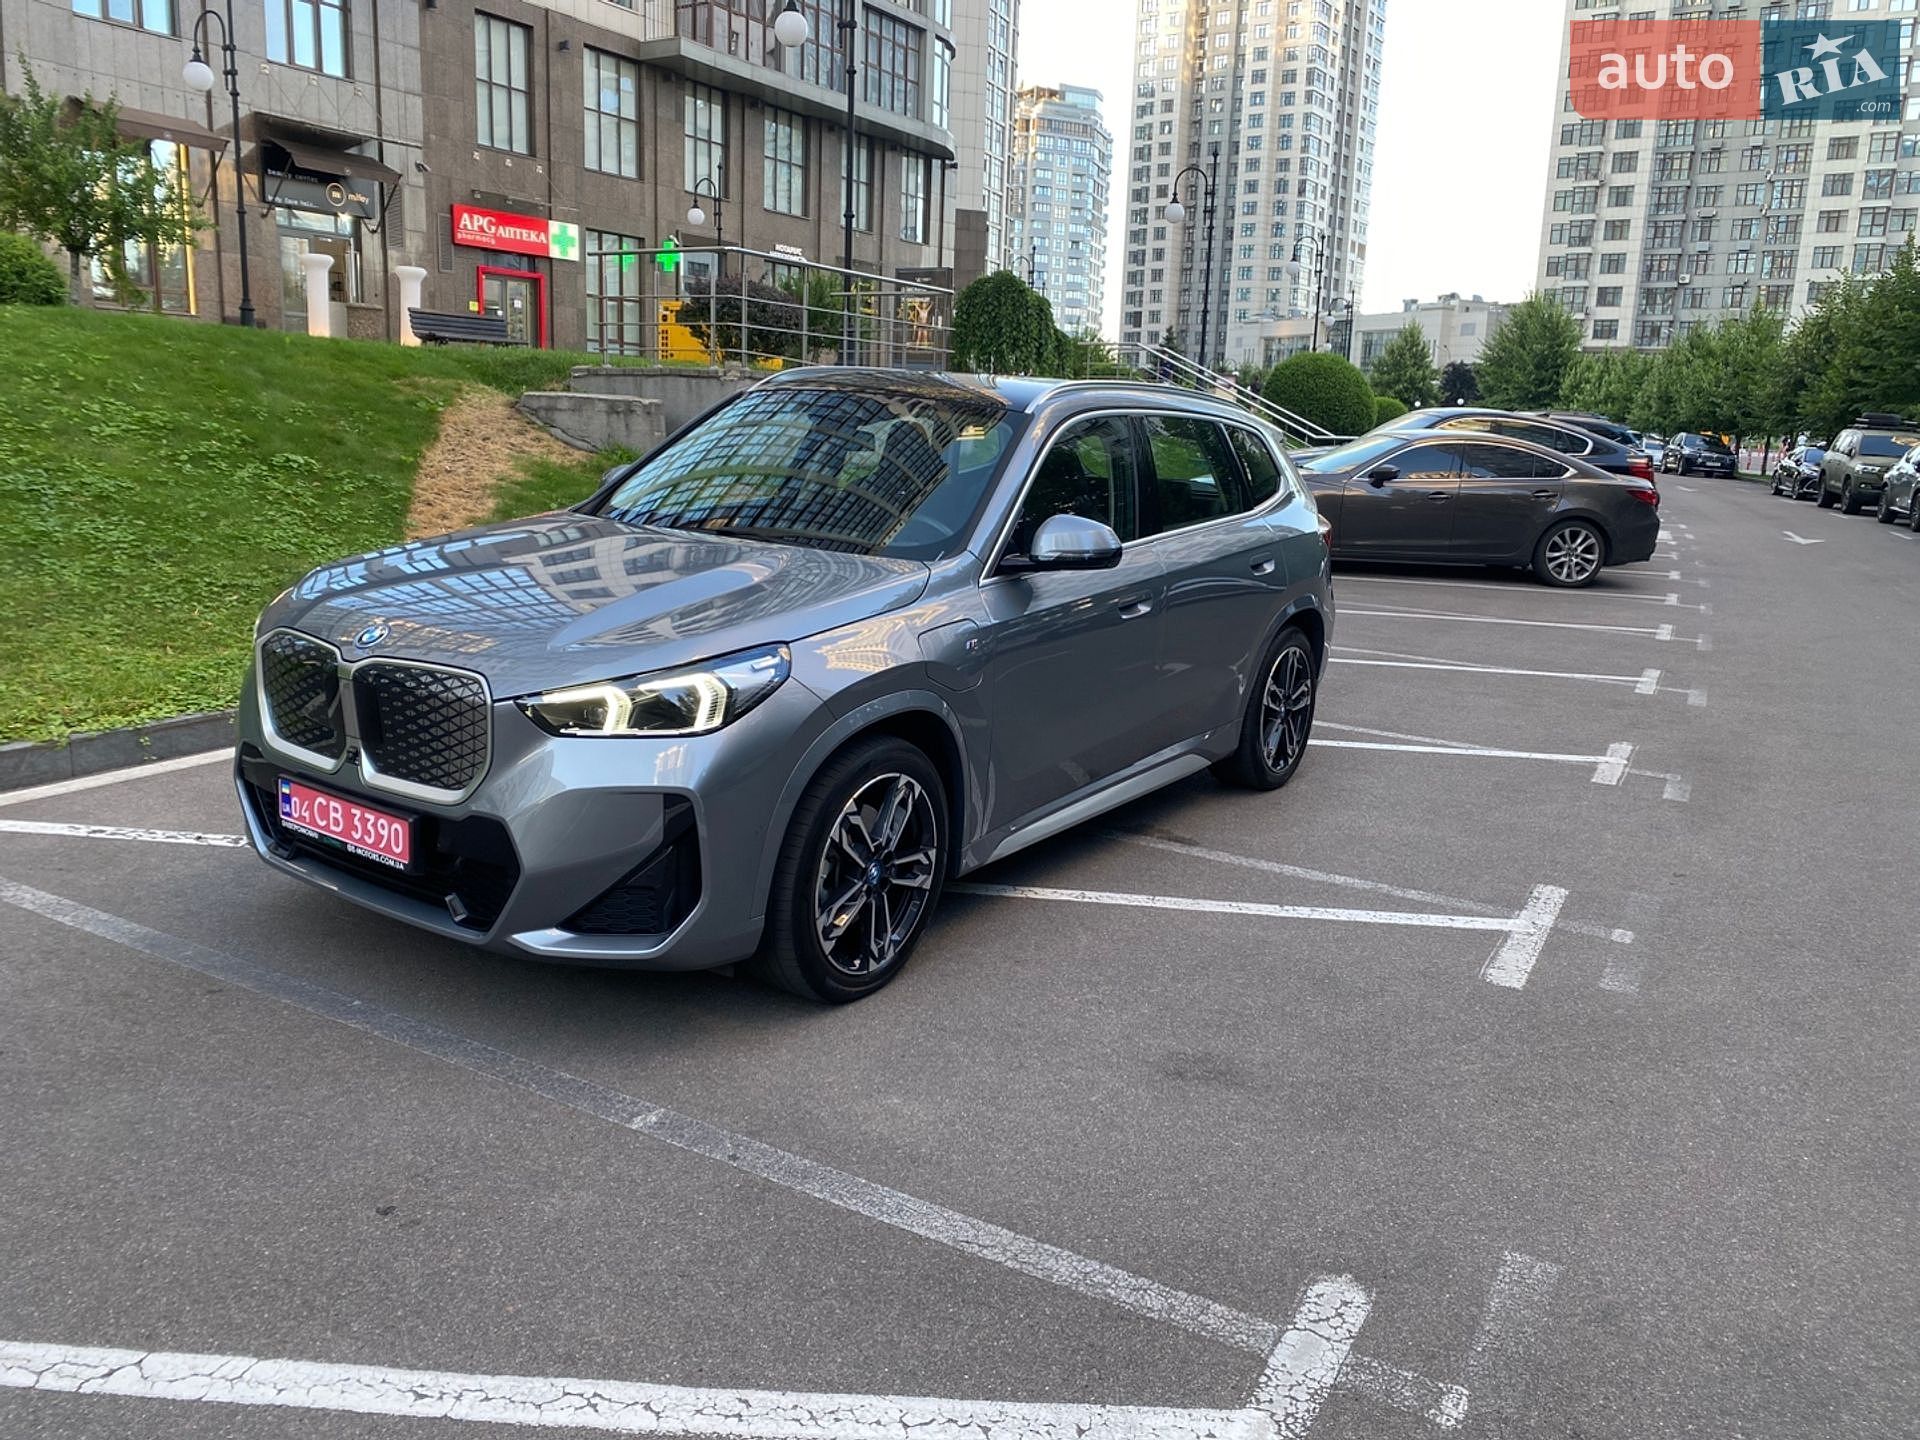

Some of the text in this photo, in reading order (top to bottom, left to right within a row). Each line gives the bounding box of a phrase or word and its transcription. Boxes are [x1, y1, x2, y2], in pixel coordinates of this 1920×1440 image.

[459, 212, 496, 234] APG
[496, 225, 548, 244] АПТЕКА
[291, 797, 310, 822] 04
[314, 797, 344, 833] CB
[351, 808, 403, 854] 3390
